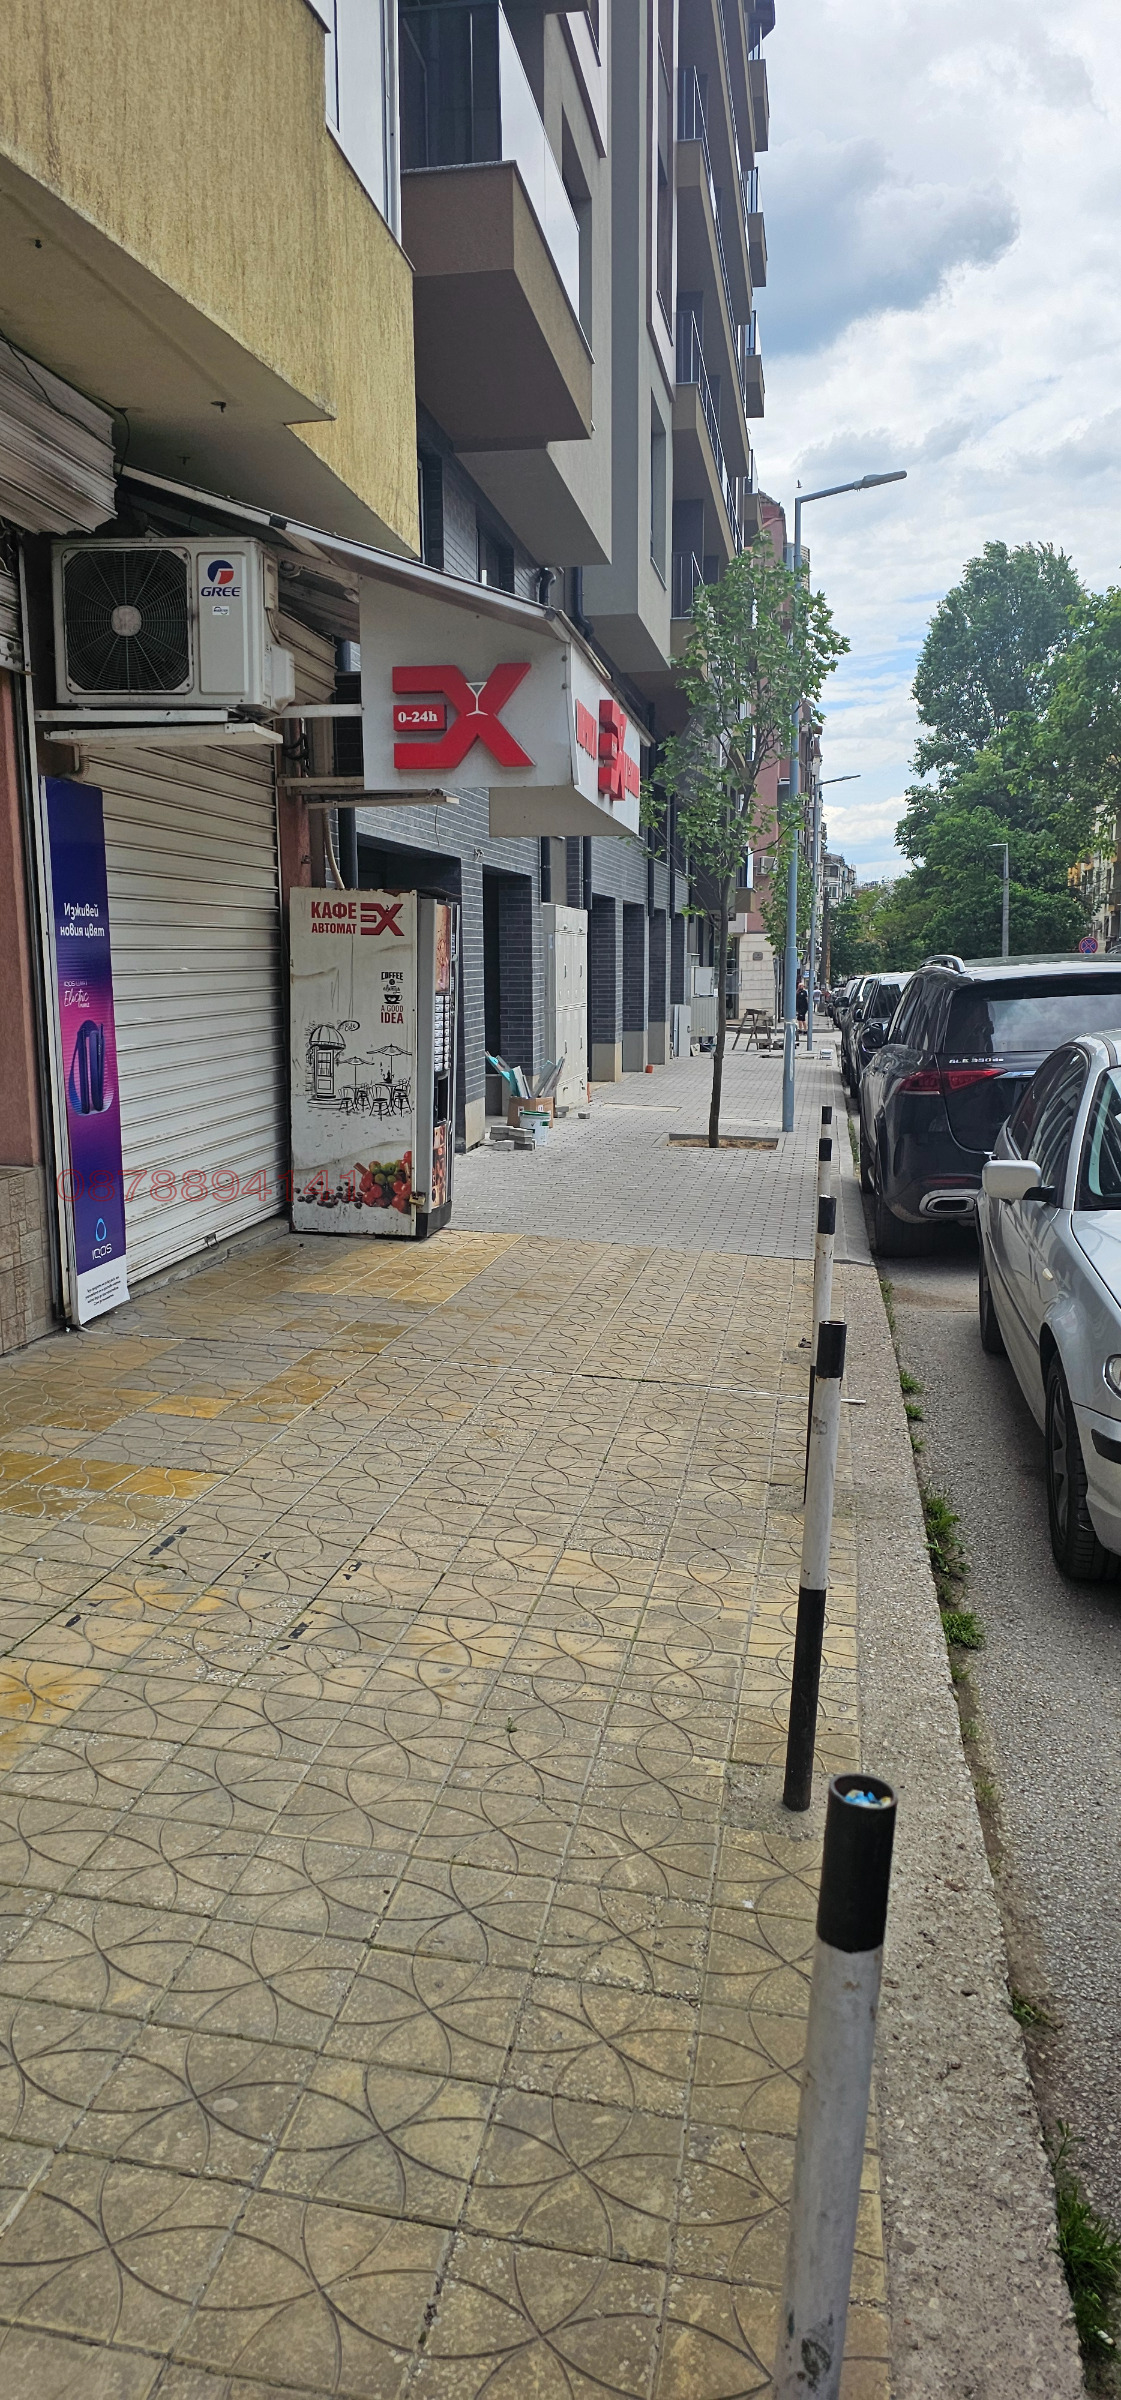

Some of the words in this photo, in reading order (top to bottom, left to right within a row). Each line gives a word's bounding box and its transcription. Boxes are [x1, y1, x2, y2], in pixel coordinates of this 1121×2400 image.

[200, 586, 242, 597] GREE
[397, 710, 438, 724] 0-24h
[63, 902, 99, 921] Изживей
[311, 901, 357, 920] КАФЕ
[60, 922, 84, 937] новия
[84, 922, 105, 938] цвят
[311, 922, 357, 935] АВТОМАТ
[381, 971, 404, 981] COFFEE
[380, 1004, 385, 1012] A
[386, 1004, 404, 1013] GOOD
[380, 1012, 404, 1024] IDEA
[91, 1243, 113, 1260] IQOS
